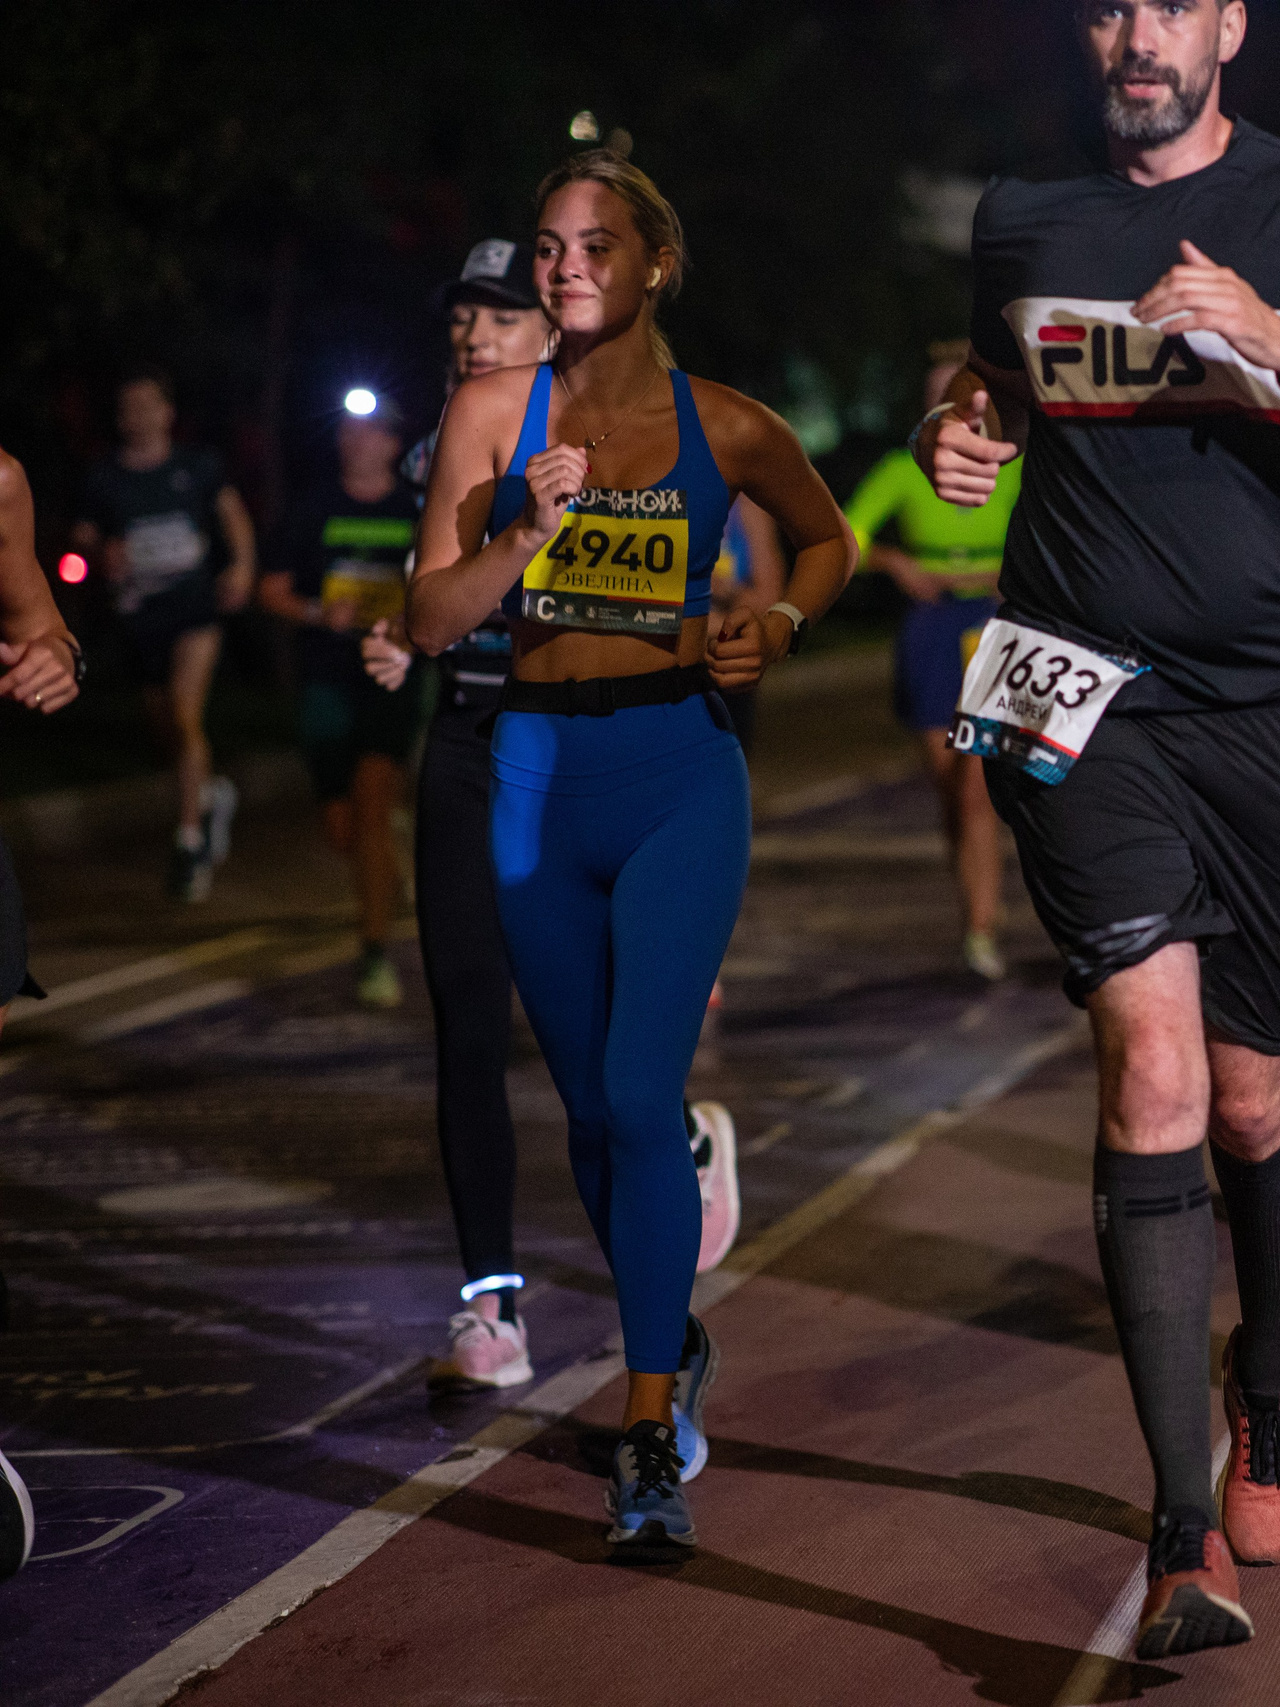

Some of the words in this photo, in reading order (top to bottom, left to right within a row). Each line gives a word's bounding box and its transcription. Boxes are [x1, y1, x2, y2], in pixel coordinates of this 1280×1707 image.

[1038, 325, 1206, 387] FILA
[575, 487, 682, 513] ОЧНОЙ
[546, 526, 675, 574] 4940
[558, 573, 654, 593] ЭВЕЛИНА
[992, 638, 1102, 709] 1633
[953, 719, 976, 750] D
